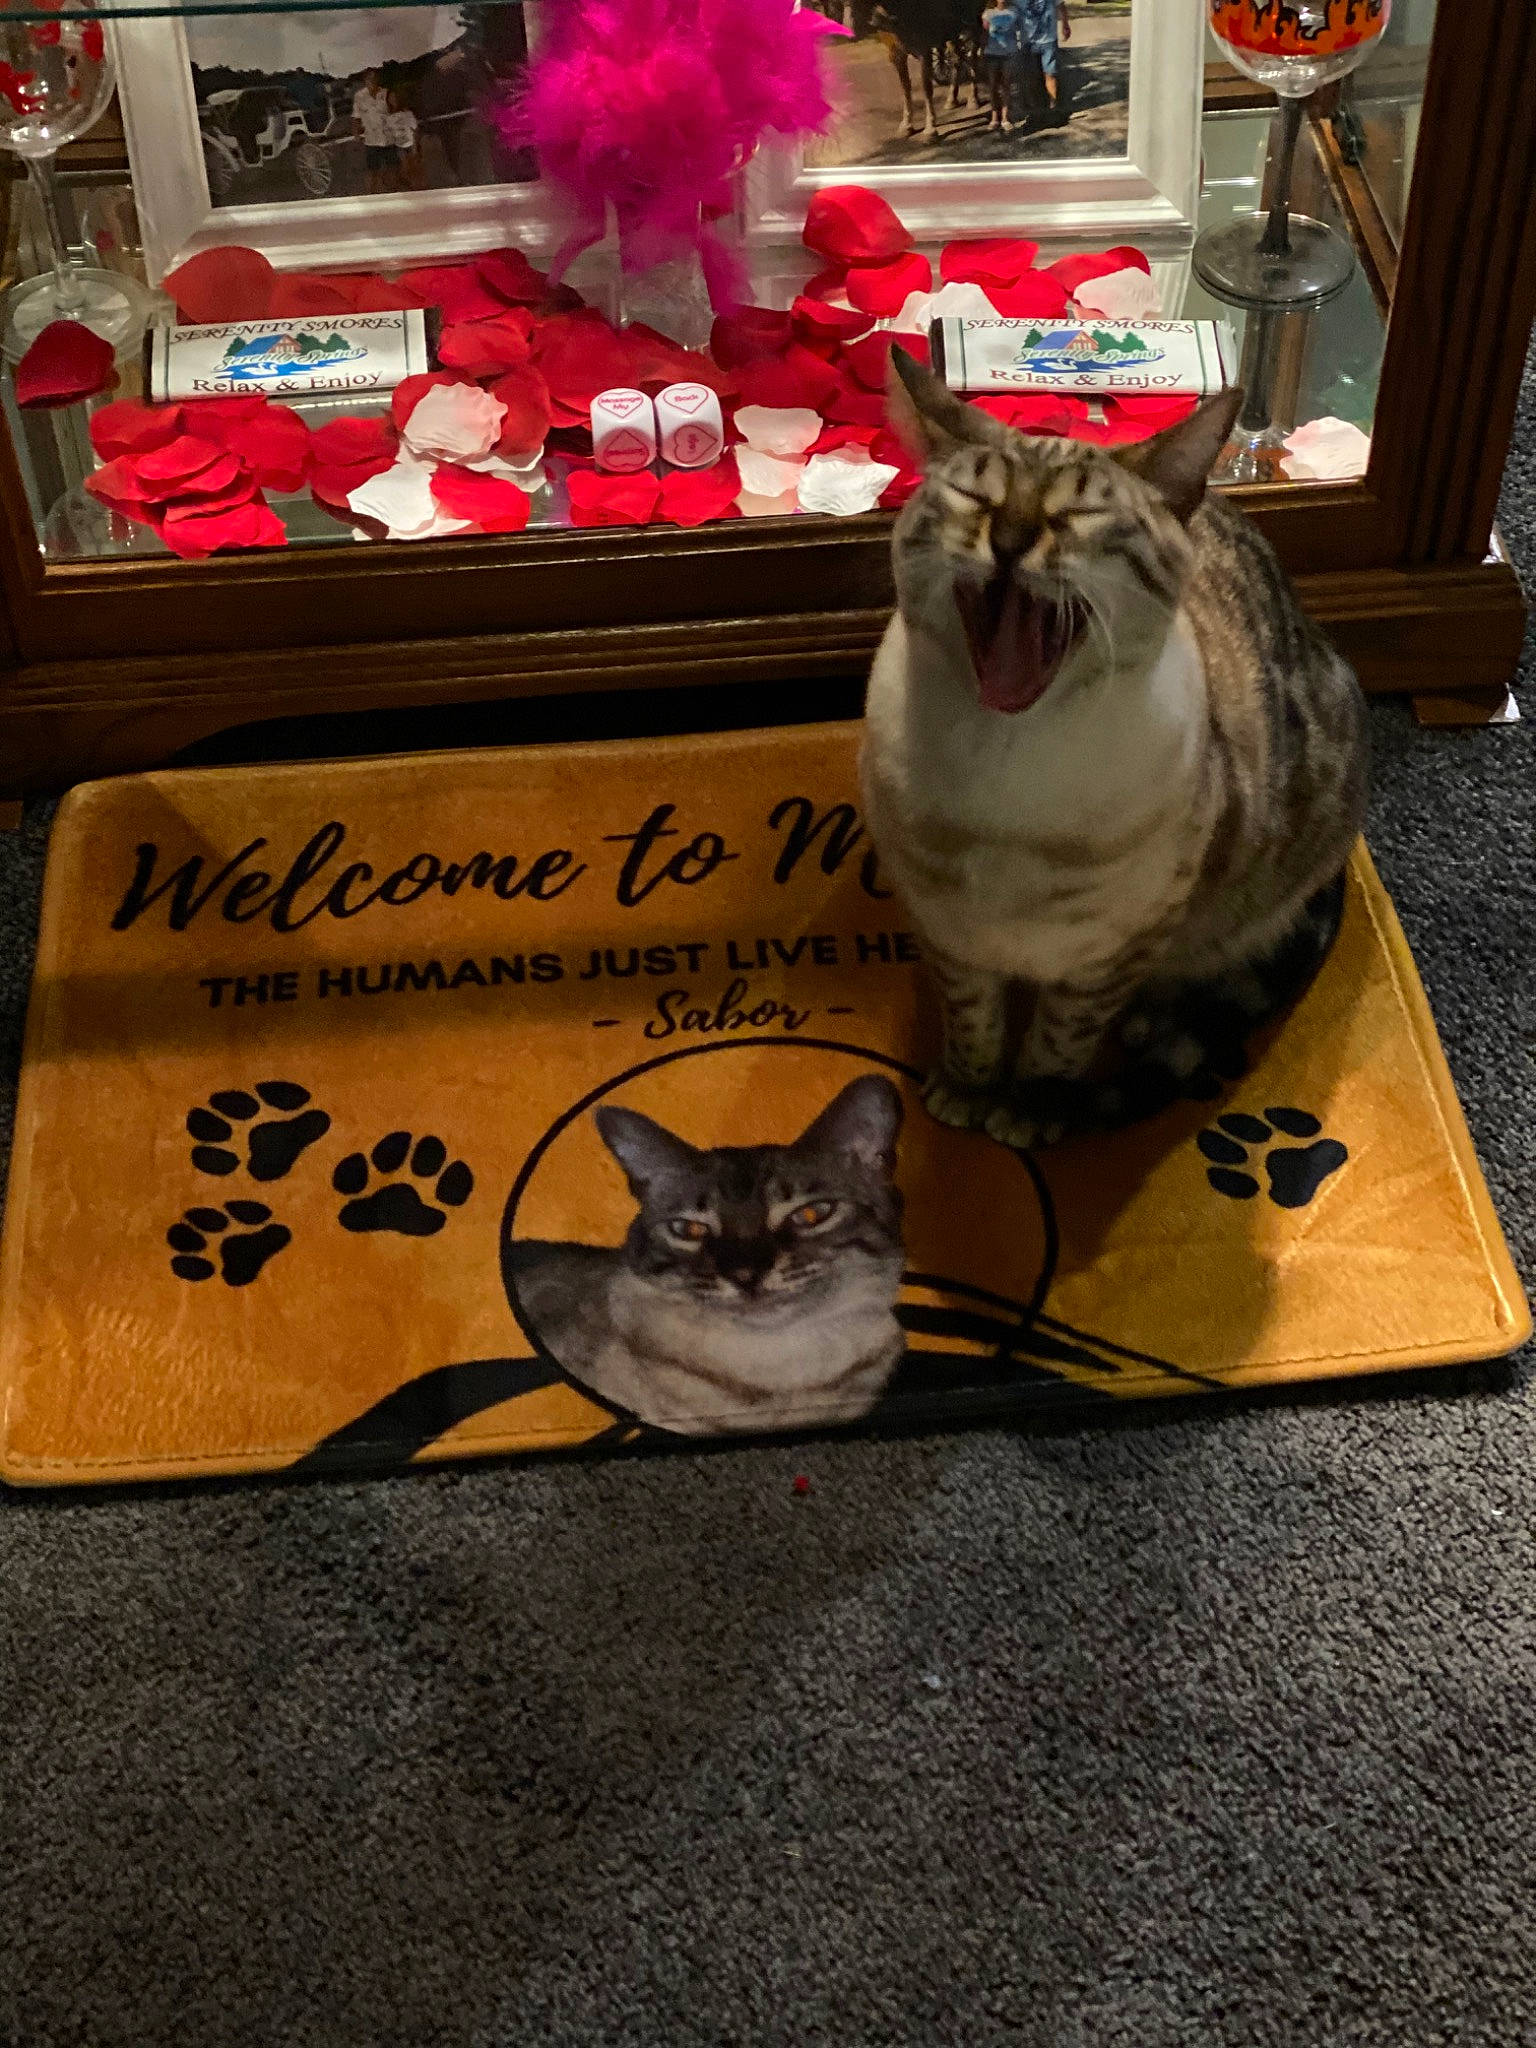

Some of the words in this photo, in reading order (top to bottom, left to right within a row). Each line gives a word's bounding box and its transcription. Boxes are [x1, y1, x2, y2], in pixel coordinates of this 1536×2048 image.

[169, 320, 301, 345] SERENITY
[964, 319, 1088, 331] SERENITY
[192, 378, 264, 393] Relax
[276, 378, 300, 392] &
[308, 370, 383, 390] Enjoy
[989, 368, 1065, 385] Relax
[1073, 373, 1098, 386] &
[1106, 373, 1184, 389] Enjoy
[110, 820, 588, 933] Welcome
[603, 802, 741, 908] to
[768, 796, 894, 899] M
[200, 971, 299, 1008] THE
[318, 953, 564, 998] HUMANS
[579, 943, 708, 981] JUST
[726, 935, 838, 970] LIVE
[856, 932, 921, 964] HE
[643, 977, 812, 1040] Sabor
